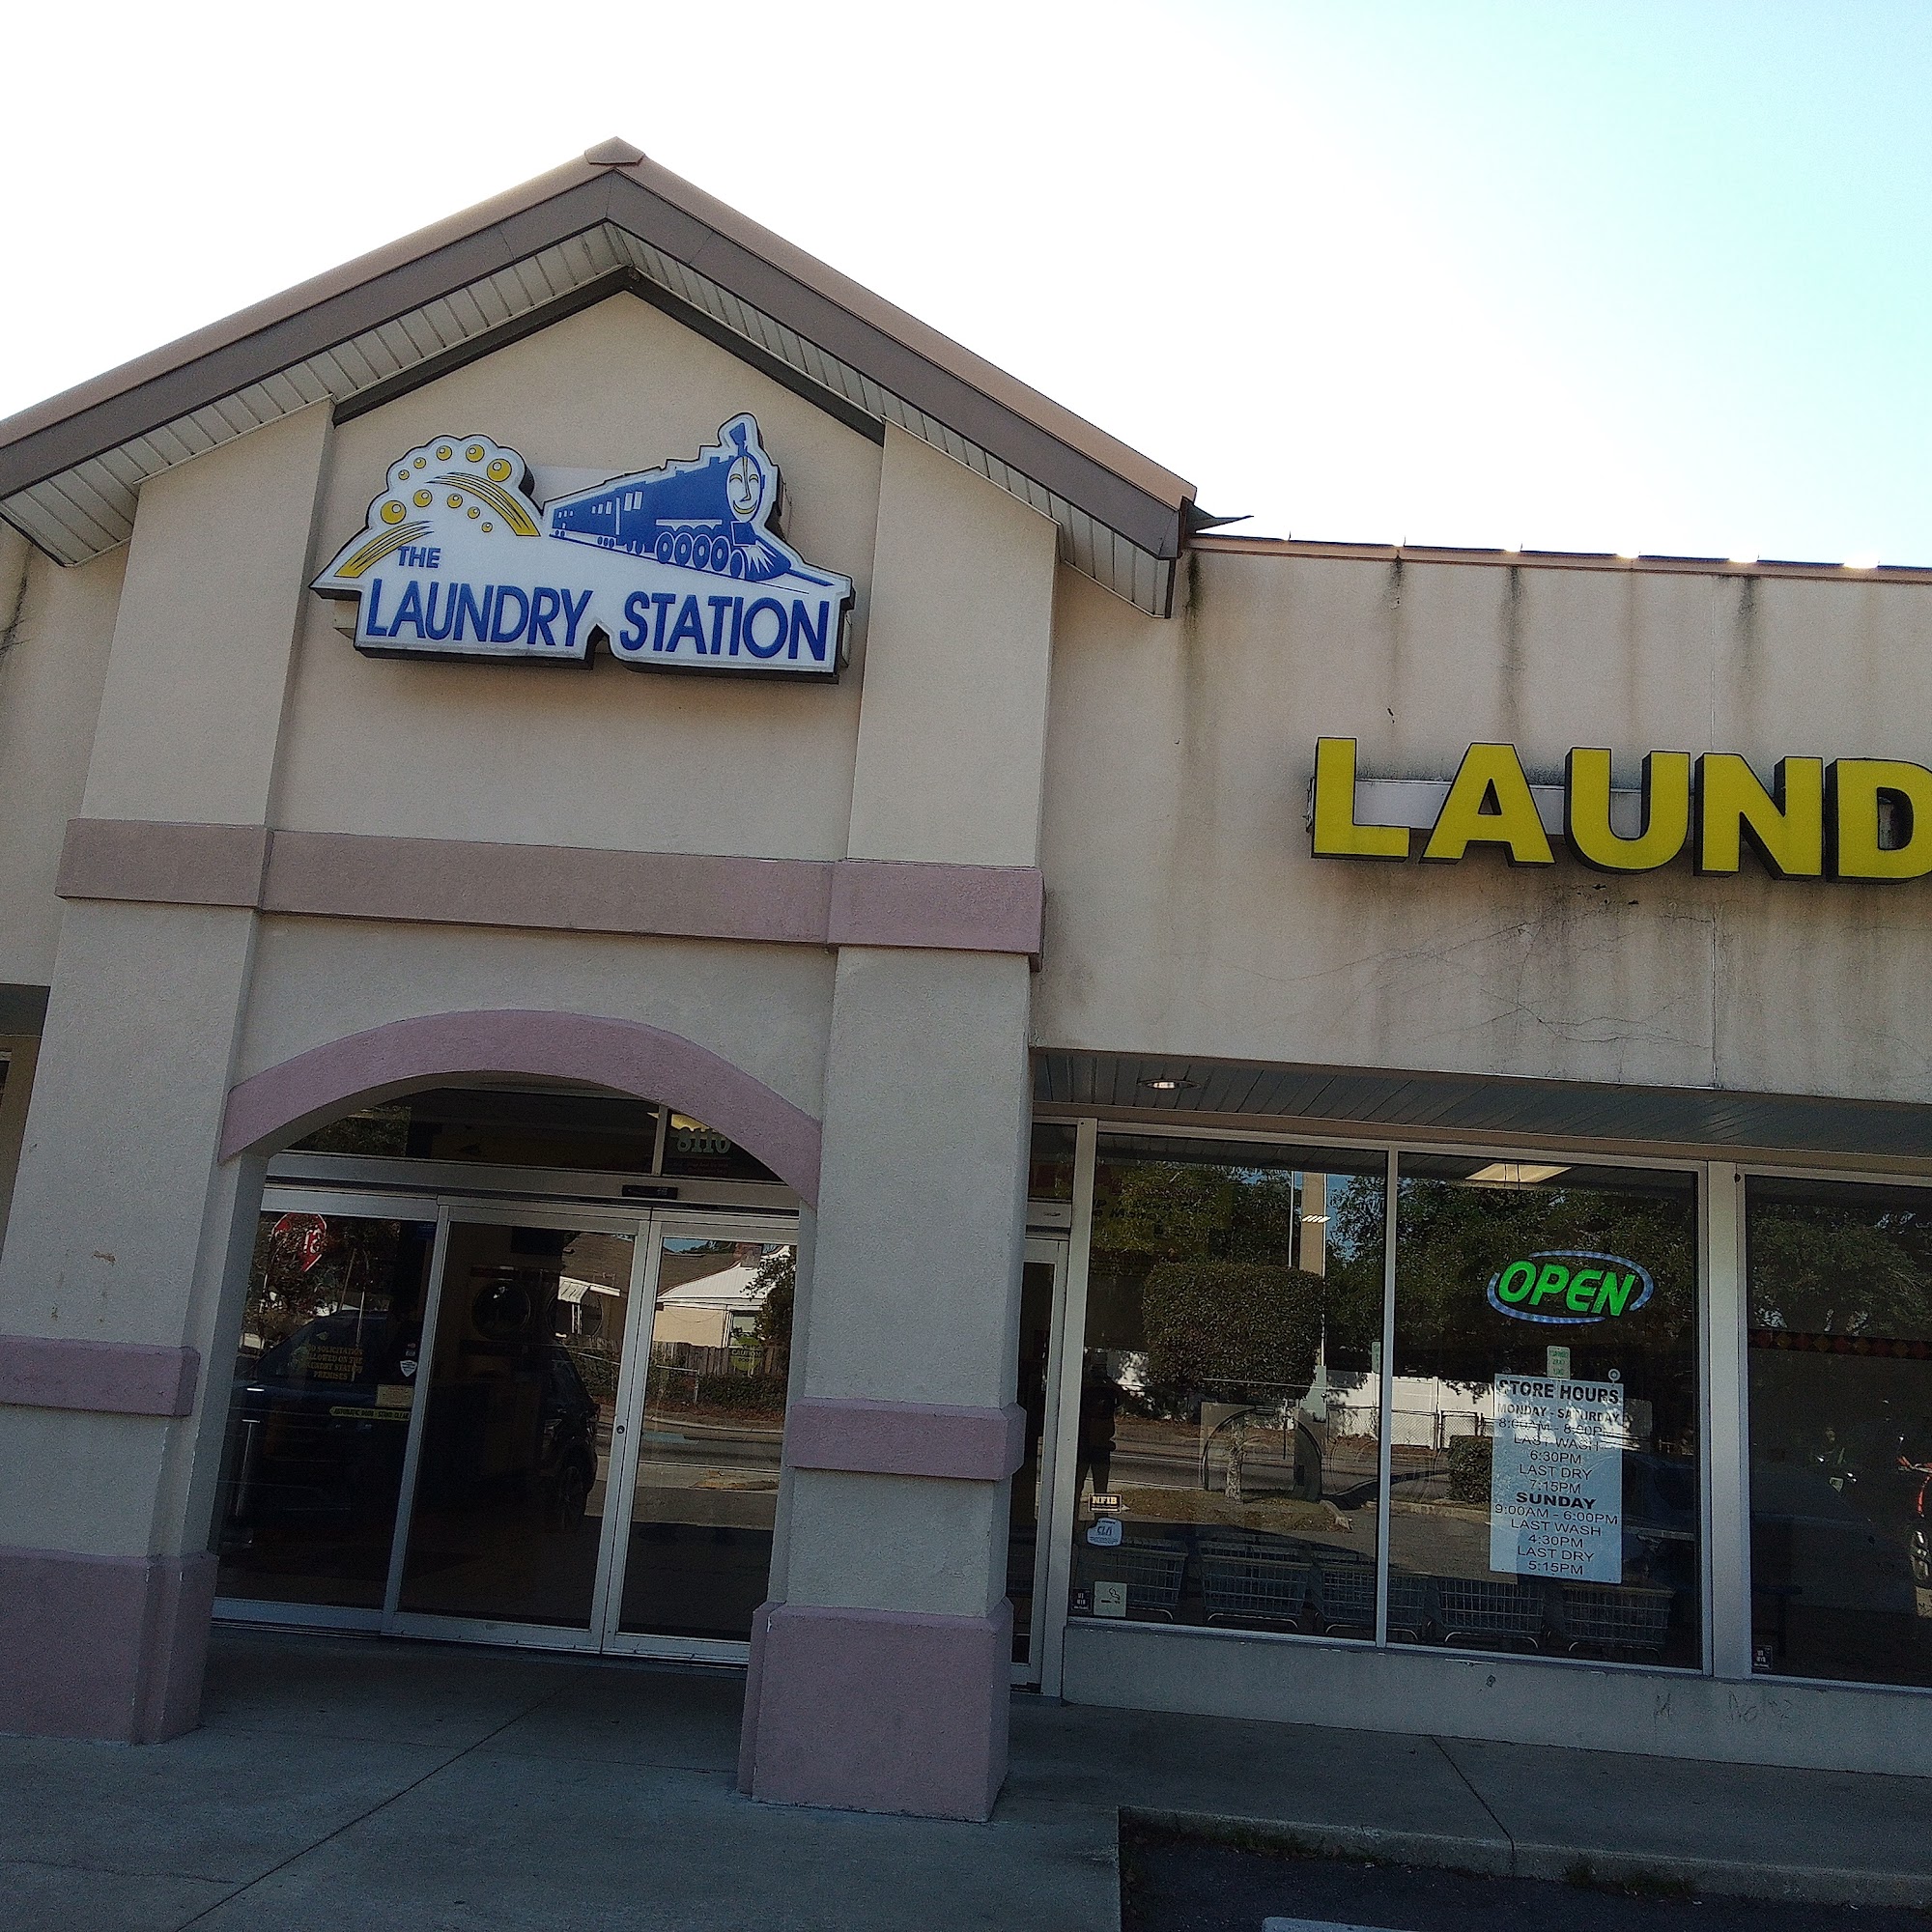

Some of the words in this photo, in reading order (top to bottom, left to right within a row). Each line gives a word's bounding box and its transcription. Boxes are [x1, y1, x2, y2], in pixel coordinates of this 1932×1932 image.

[397, 545, 441, 569] THE
[366, 578, 594, 648] LAUNDRY
[619, 590, 831, 662] STATION
[1311, 736, 1932, 883] LAUND
[1498, 1260, 1636, 1317] OPEN
[1499, 1379, 1554, 1399] STORE
[1559, 1384, 1619, 1405] HOURS
[1497, 1403, 1547, 1417] MONDAY
[1514, 1435, 1549, 1447] LAST
[1555, 1437, 1599, 1452] WASH
[1530, 1450, 1582, 1464] 6:30PM
[1519, 1463, 1556, 1477] LAST
[1561, 1467, 1593, 1480] DRY
[1529, 1479, 1581, 1494] 7:15PM
[1092, 1495, 1118, 1505] NFIB
[1516, 1492, 1597, 1509] SUNDAY
[1494, 1503, 1548, 1519] 9:00AM
[1563, 1510, 1618, 1525] 6:00PM
[1511, 1519, 1550, 1531] LAST
[1554, 1522, 1602, 1536] WASH
[1528, 1534, 1583, 1548] 4:30PM
[1518, 1546, 1556, 1558] LAST
[1561, 1549, 1595, 1562] DRY
[1528, 1560, 1583, 1576] 5:15PM
